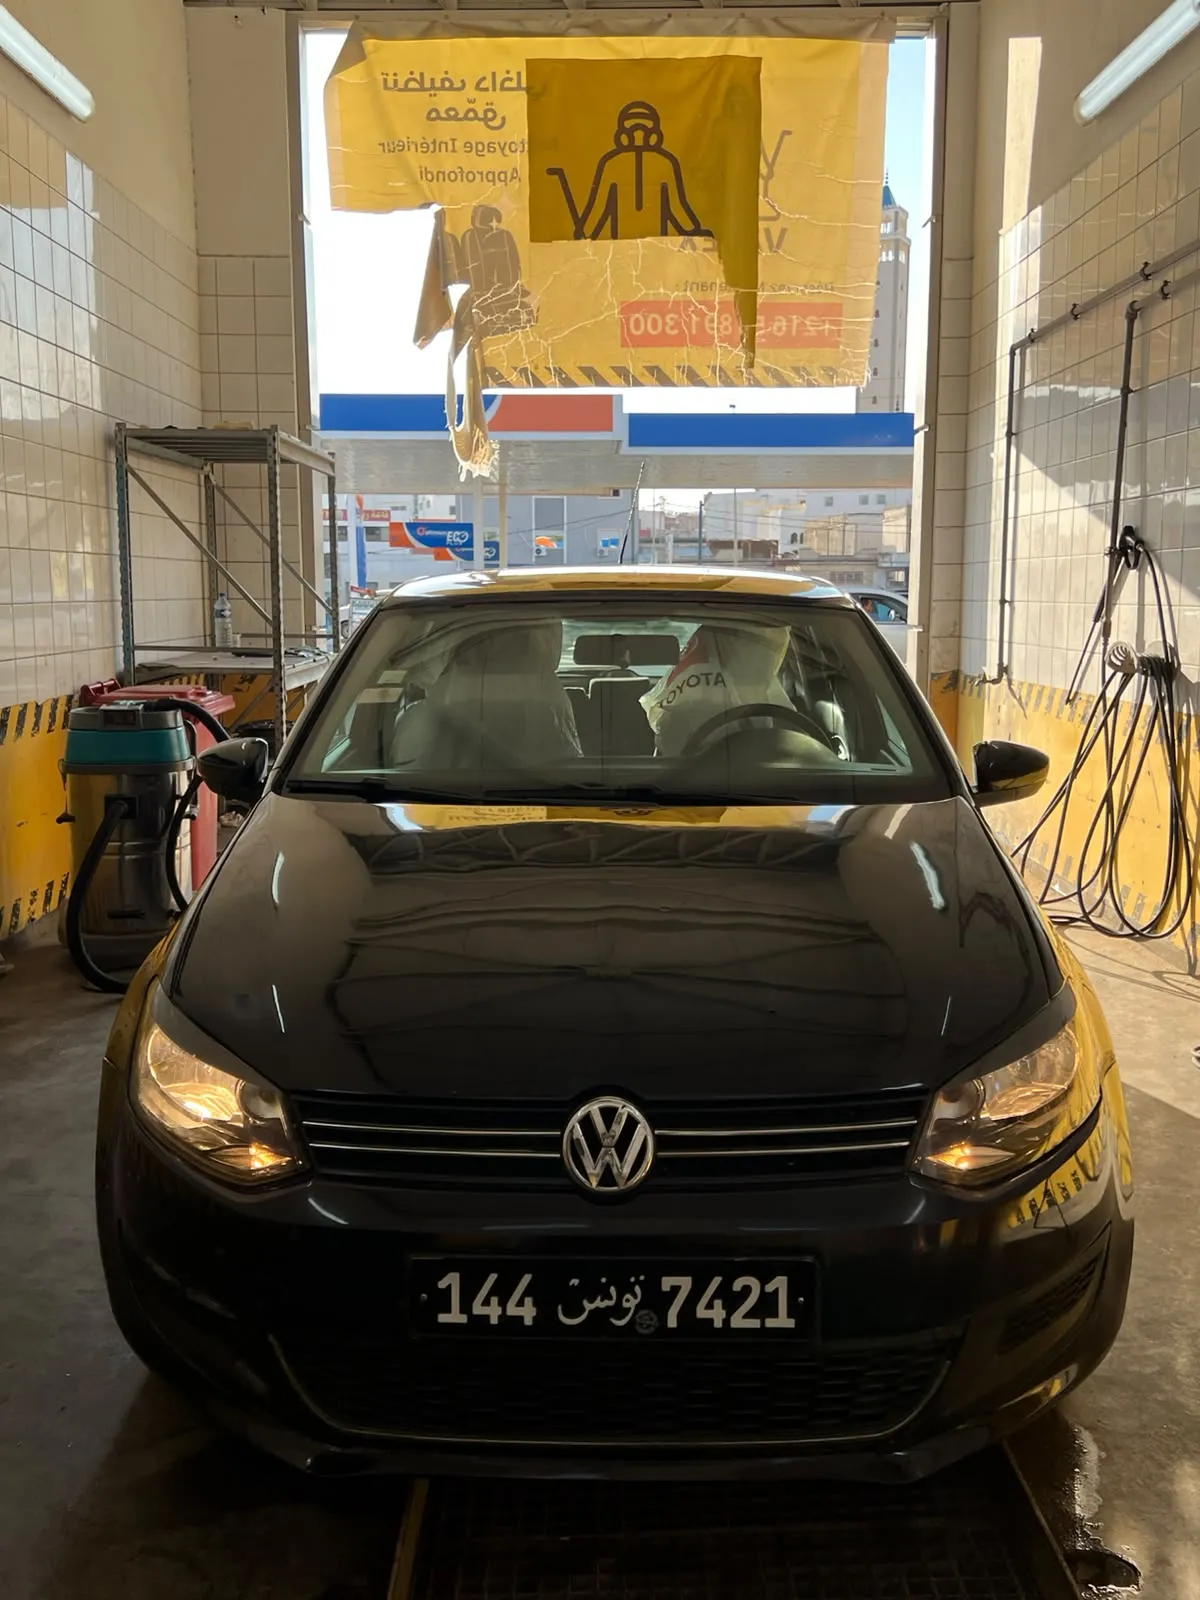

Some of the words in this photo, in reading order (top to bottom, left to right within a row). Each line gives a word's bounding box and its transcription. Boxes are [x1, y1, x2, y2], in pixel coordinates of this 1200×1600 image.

[446, 530, 469, 543] ECO
[437, 1272, 537, 1326] 144
[557, 1274, 645, 1326] تونس
[661, 1276, 796, 1328] 7421
